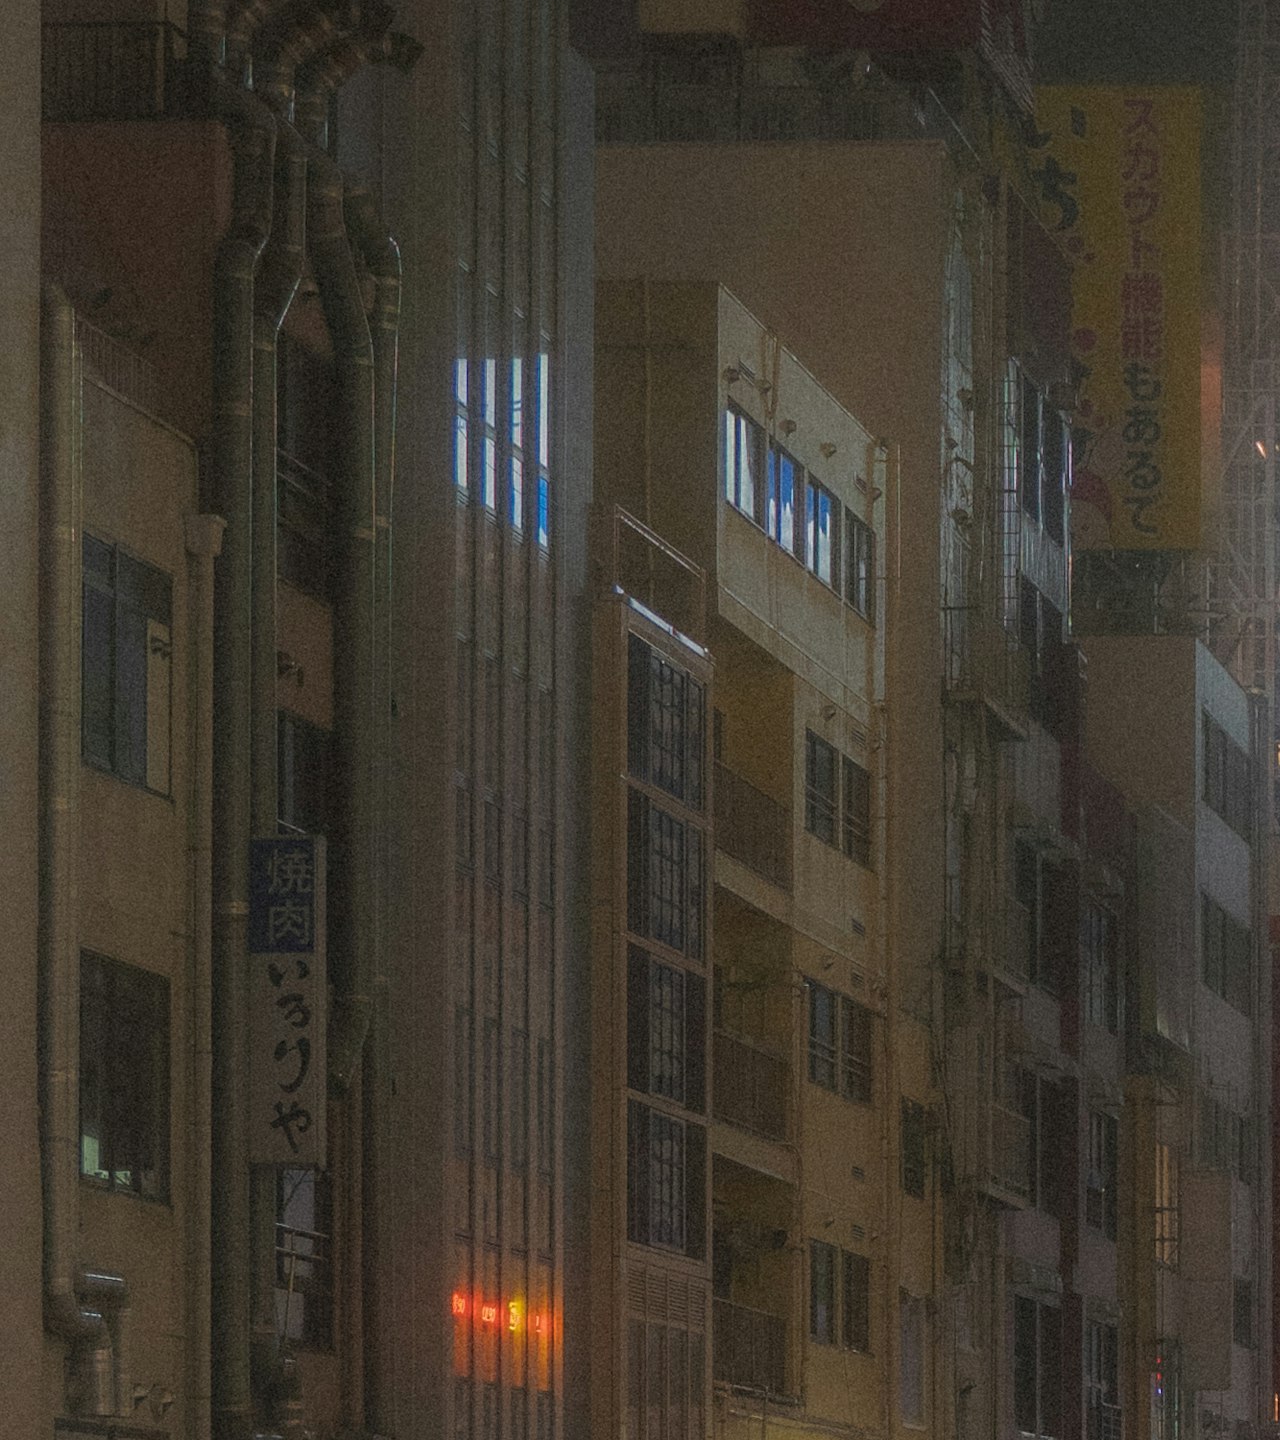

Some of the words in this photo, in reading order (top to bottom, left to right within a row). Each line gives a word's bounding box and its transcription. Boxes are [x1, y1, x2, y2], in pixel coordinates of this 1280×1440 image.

[1121, 98, 1167, 536] スカウト機能もあるで
[267, 849, 311, 945] 焼肉
[267, 959, 312, 1154] いろりや
